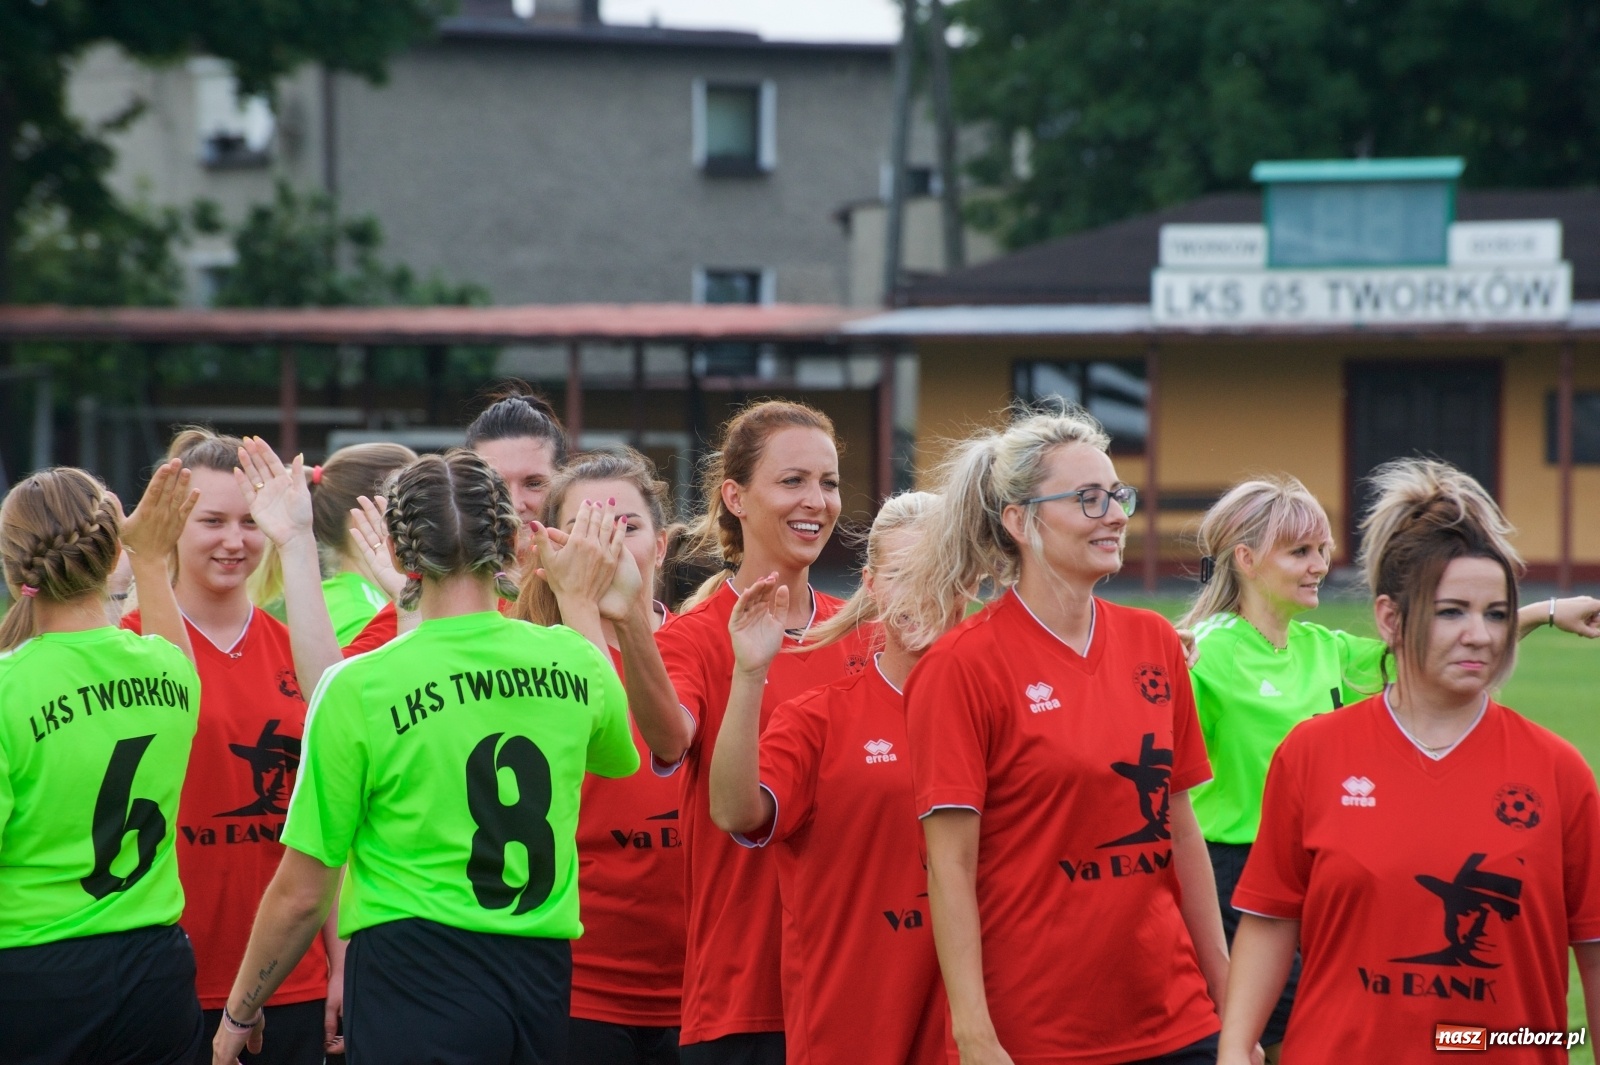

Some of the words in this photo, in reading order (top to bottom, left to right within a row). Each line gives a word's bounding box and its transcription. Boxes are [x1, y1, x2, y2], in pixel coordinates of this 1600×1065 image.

[1164, 279, 1244, 316] LKS
[1261, 278, 1307, 313] 05
[1328, 267, 1558, 315] TWORKÓW
[29, 694, 75, 743] LKS
[77, 671, 190, 717] TWORKÓW
[390, 681, 445, 735] LKS
[450, 661, 589, 706] TWORKÓW
[1030, 698, 1061, 713] errea
[865, 753, 897, 764] errea
[80, 733, 167, 901] 6
[466, 732, 556, 916] 8
[181, 826, 216, 846] Va
[610, 829, 652, 849] Va
[1058, 859, 1101, 882] Va
[883, 908, 923, 932] Va
[1357, 966, 1391, 995] Va
[1402, 972, 1497, 1004] BANK
